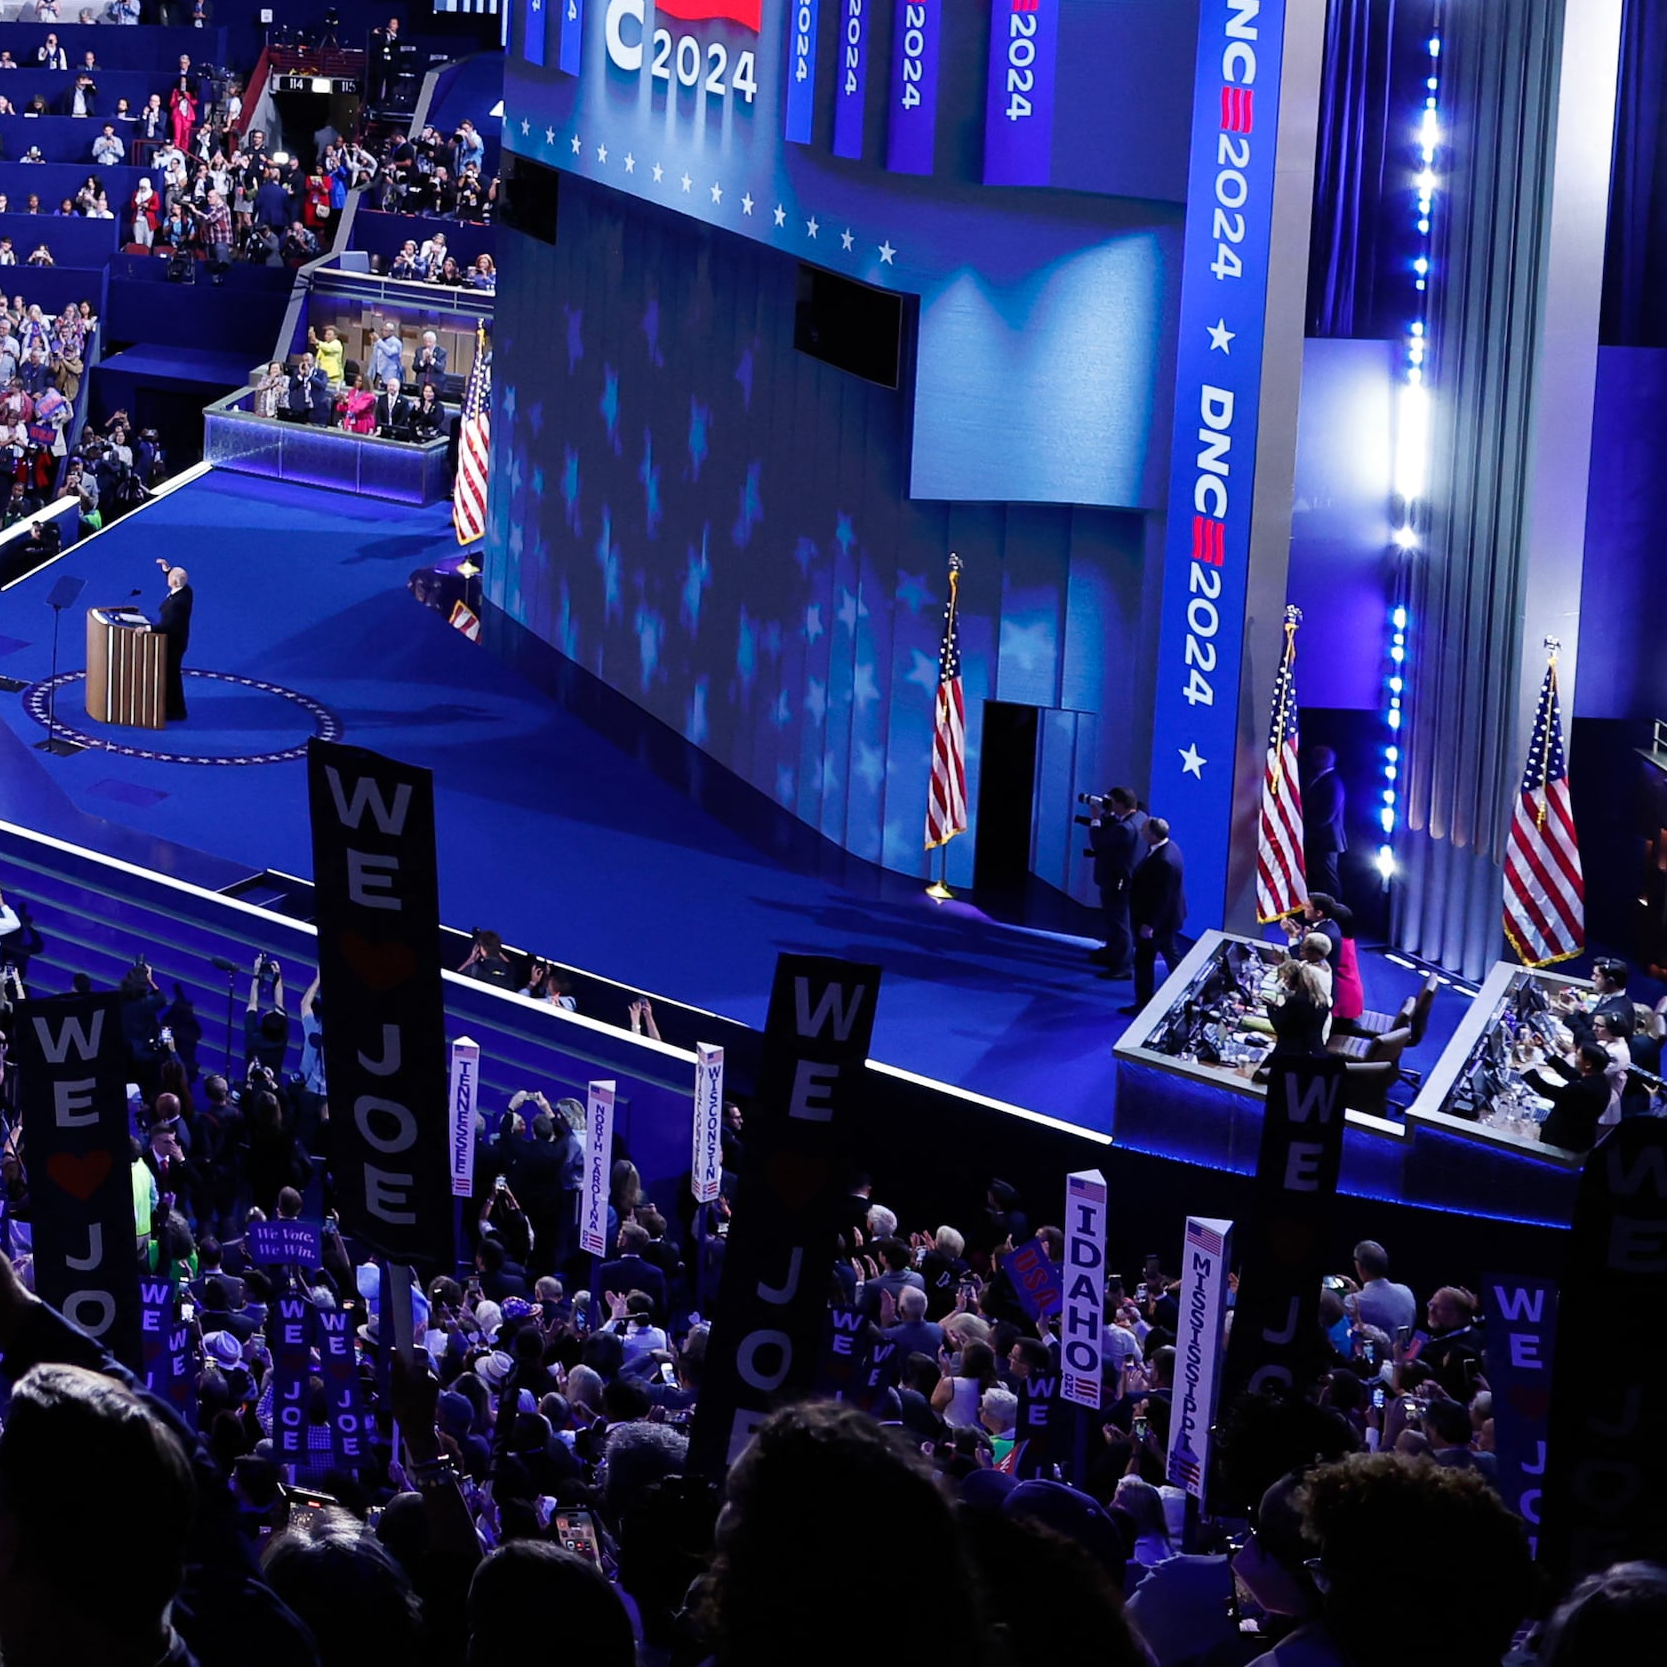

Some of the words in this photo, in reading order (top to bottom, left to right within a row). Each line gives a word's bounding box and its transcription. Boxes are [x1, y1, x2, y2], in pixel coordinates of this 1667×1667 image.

[289, 79, 303, 90] 114
[652, 27, 758, 103] 2024
[901, 2, 927, 112] 2024
[1004, 12, 1039, 122] 2024
[1210, 134, 1253, 282] 2024
[1193, 383, 1235, 521] DNC
[1182, 561, 1223, 707] 2024
[324, 764, 414, 911] WE
[32, 1008, 107, 1127] WE
[788, 975, 866, 1124] WE
[354, 1022, 419, 1225] JOE
[456, 1062, 471, 1175] TENNESSEE
[595, 1105, 605, 1152] NORTH
[708, 1065, 722, 1180] WISCONSIN
[258, 1228, 278, 1240] We
[588, 1156, 601, 1231] CAROLINA
[259, 1245, 278, 1256] We
[1014, 1248, 1061, 1309] USA
[1067, 1204, 1101, 1372] IDAHO
[280, 1299, 305, 1343] WE
[282, 1382, 302, 1450] JOE
